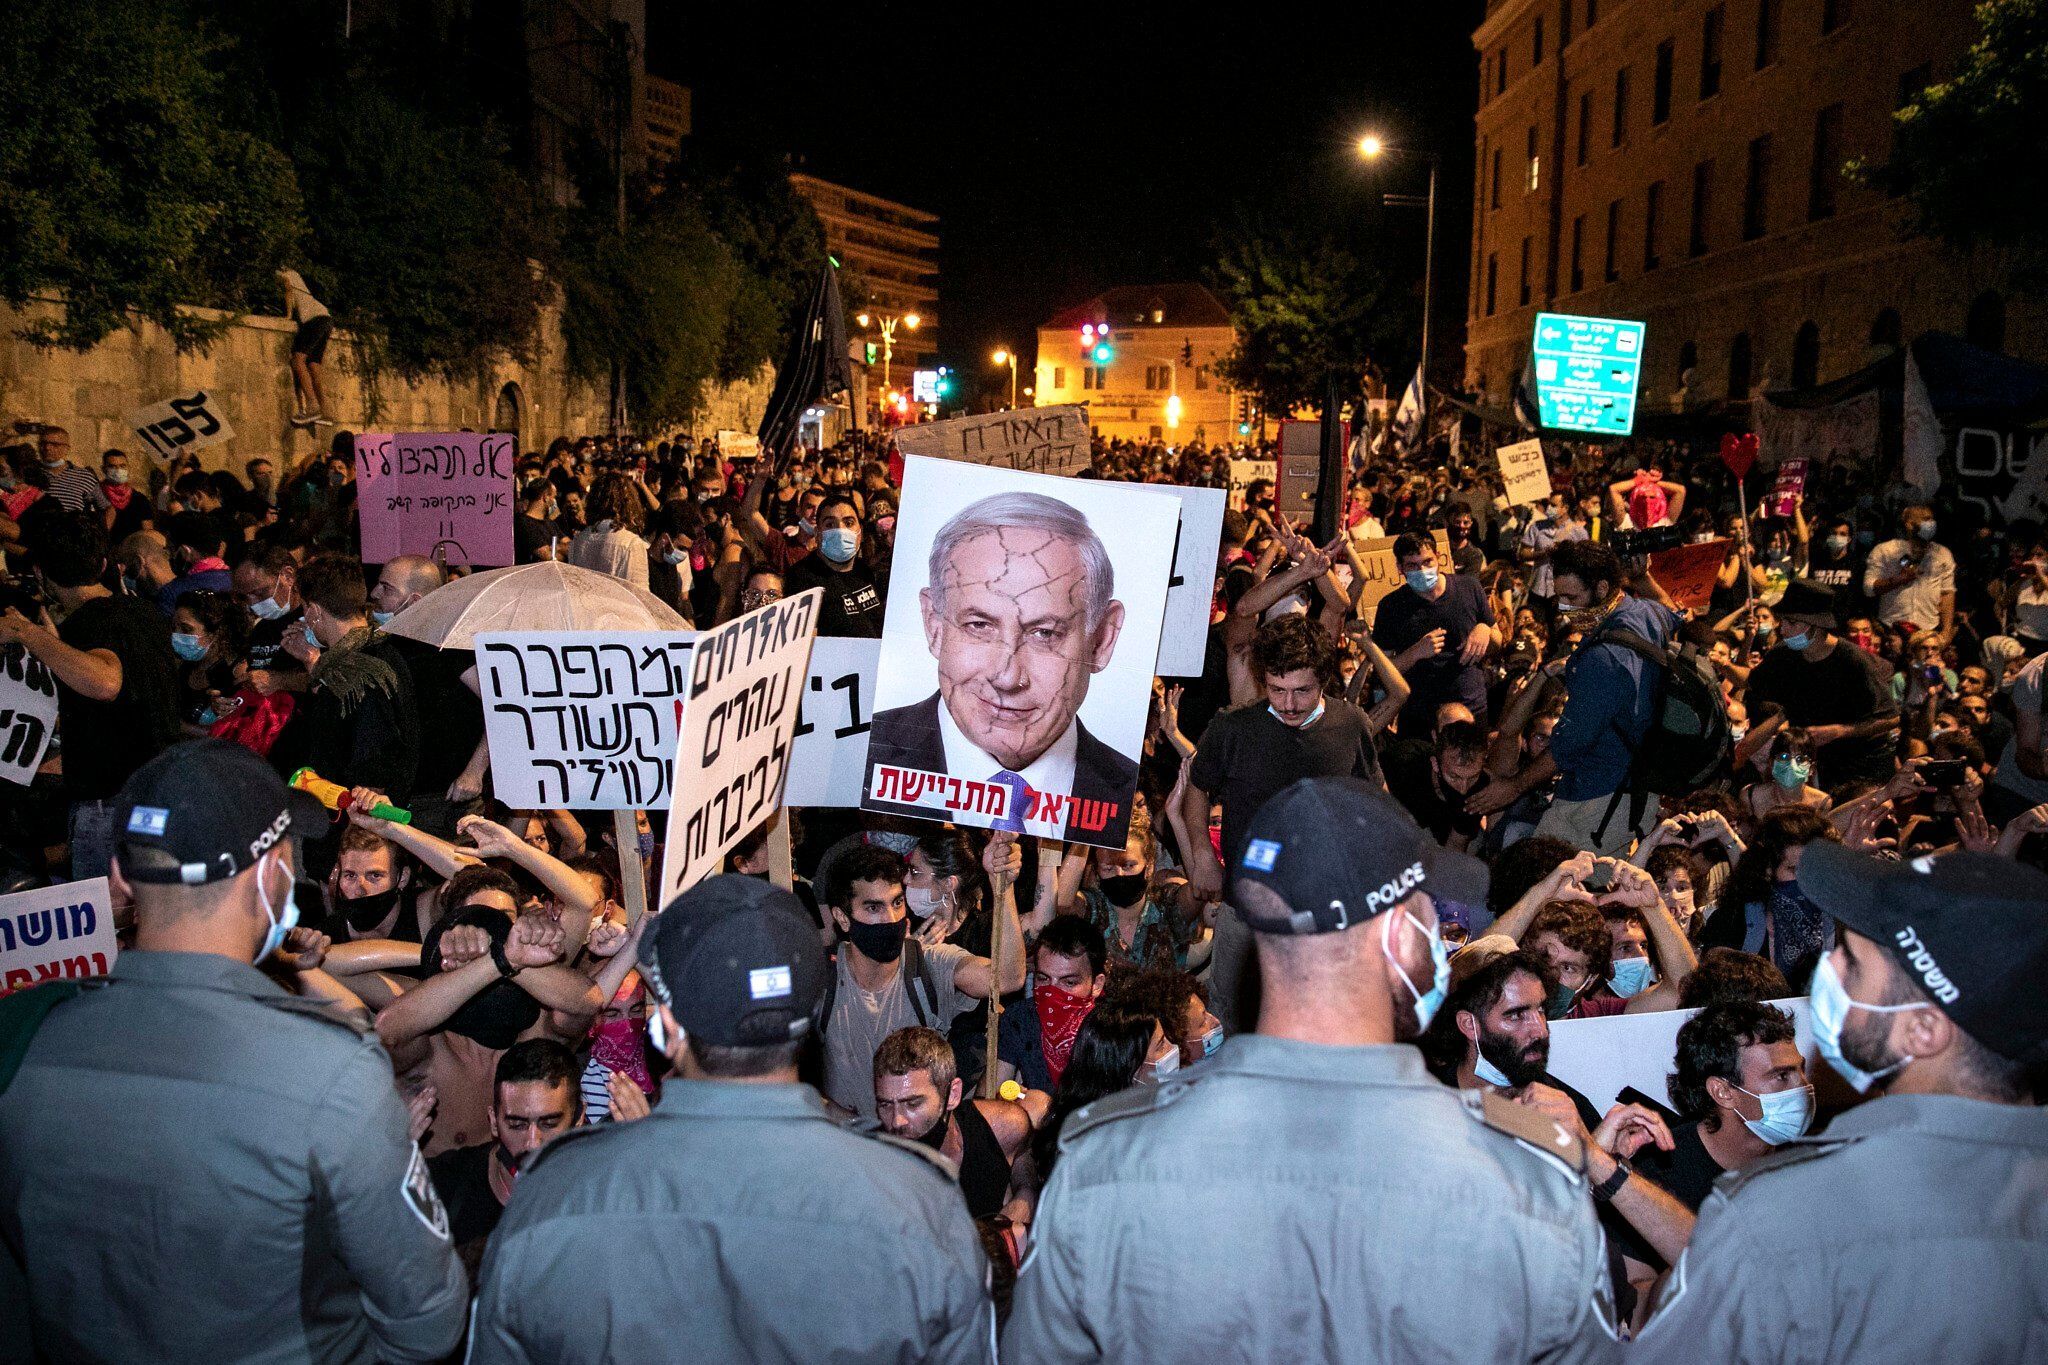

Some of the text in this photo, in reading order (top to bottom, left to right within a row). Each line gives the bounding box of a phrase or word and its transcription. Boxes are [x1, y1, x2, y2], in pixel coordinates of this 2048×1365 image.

[136, 390, 220, 459] לכו!
[358, 441, 392, 478] לי!
[473, 437, 510, 480] אל
[386, 492, 508, 515] אני בתקופה קשה
[485, 642, 695, 698] המהפכה
[691, 594, 813, 700] האזרחים
[494, 701, 660, 758] תשודר
[702, 665, 791, 768] נוהרים
[676, 726, 786, 889] לכיכרות
[876, 767, 1118, 832] ישראל מתביישת
[250, 808, 292, 859] POLICE
[1366, 861, 1426, 913] POLICE
[1895, 925, 1960, 1004] משטרה
